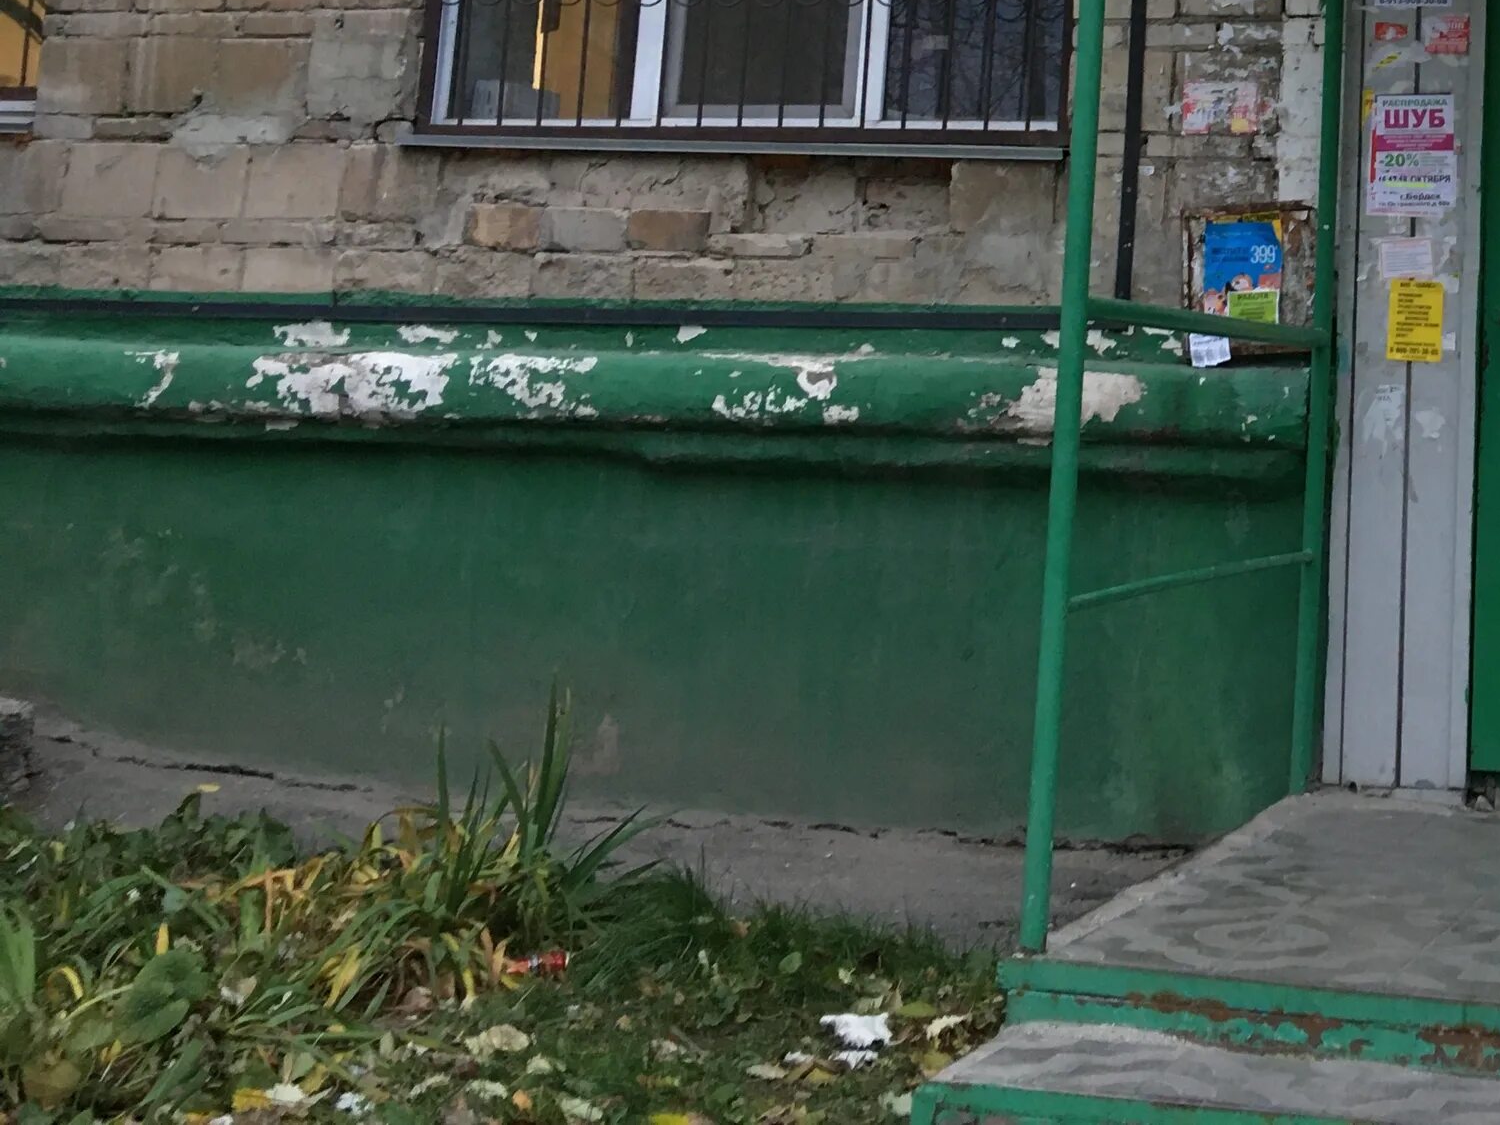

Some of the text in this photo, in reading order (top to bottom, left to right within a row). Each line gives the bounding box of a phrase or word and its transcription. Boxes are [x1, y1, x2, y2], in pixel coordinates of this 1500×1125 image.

[1382, 98, 1448, 107] РАСПРОДАЖА
[1384, 108, 1446, 129] ШУБ
[1379, 153, 1420, 167] -20%
[1250, 244, 1276, 264] 399
